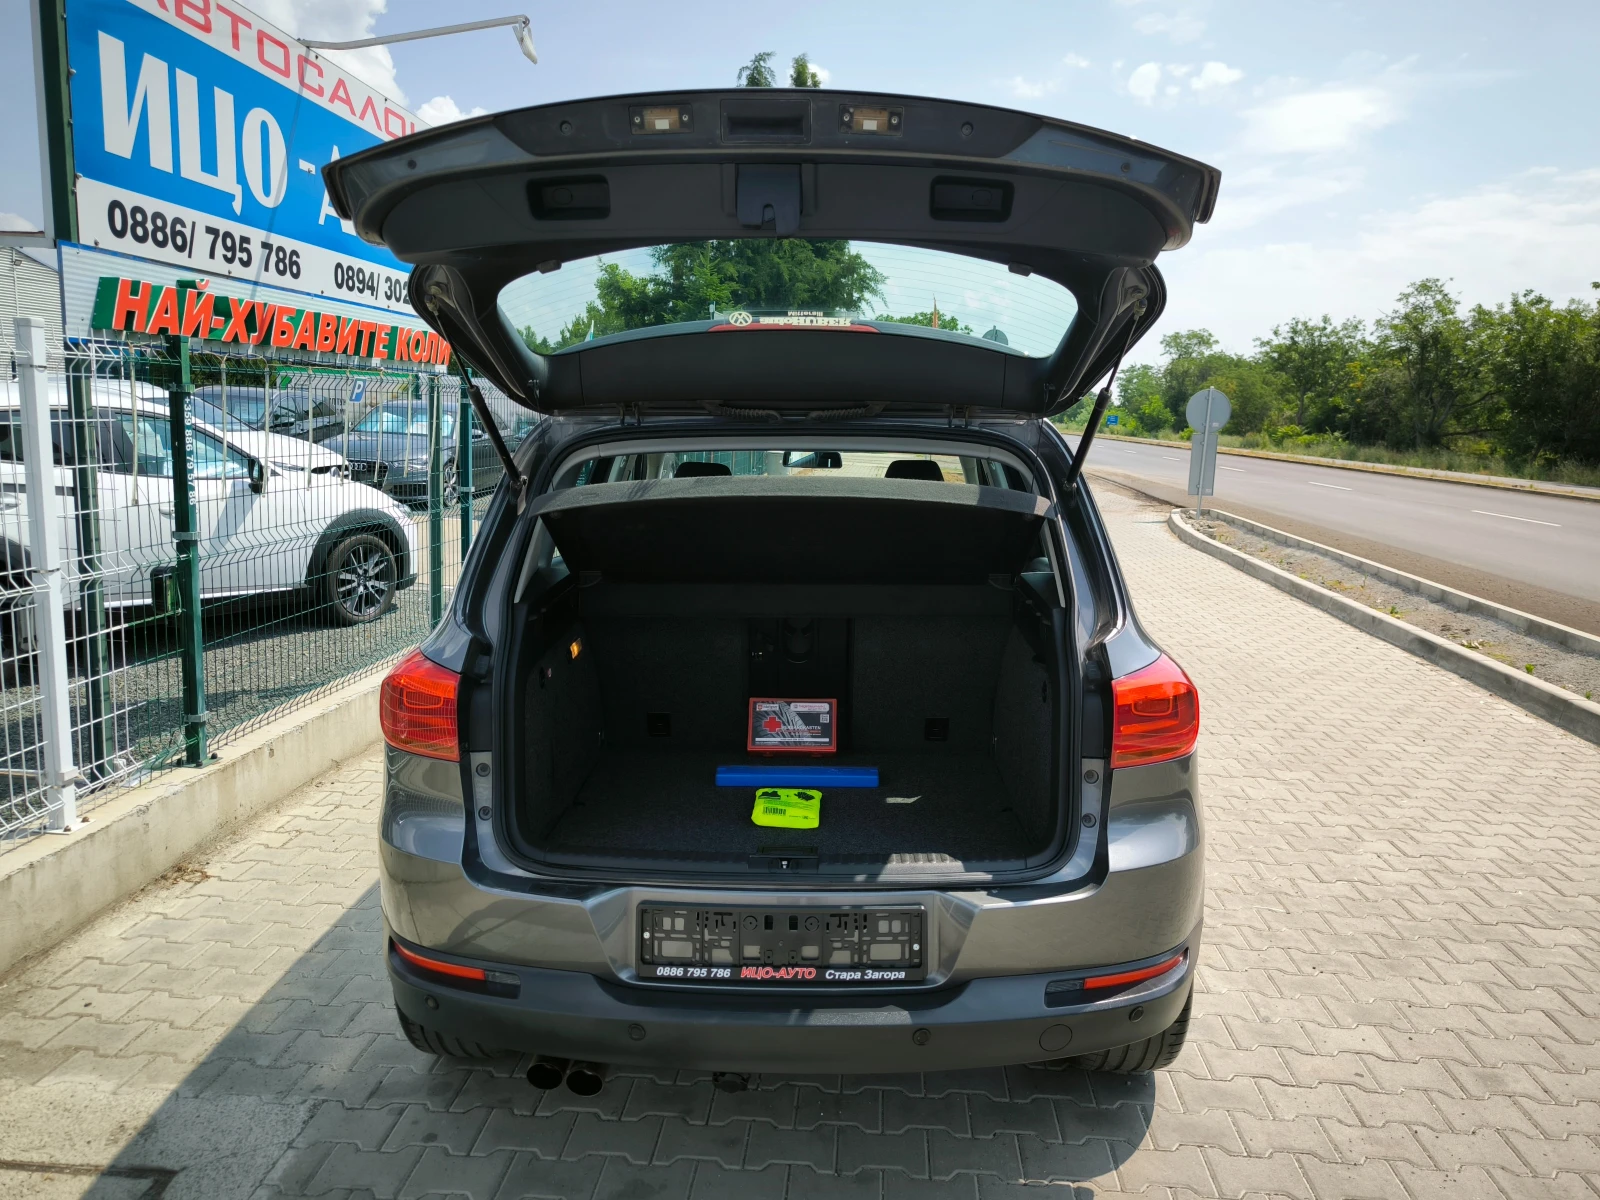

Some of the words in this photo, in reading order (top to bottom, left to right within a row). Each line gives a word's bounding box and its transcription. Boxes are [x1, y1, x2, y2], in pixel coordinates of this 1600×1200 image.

[156, 0, 415, 139] ВТОСАЛО
[205, 225, 252, 268] 795
[260, 241, 301, 280] 786
[112, 277, 391, 360] НАЙ-ХУБАВИТЕ
[395, 326, 451, 366] КОЛИ
[352, 381, 364, 399] P
[184, 396, 192, 425] +359
[185, 429, 193, 451] 886
[186, 455, 194, 469] 79
[188, 490, 197, 506] 86
[656, 967, 684, 976] 0886
[687, 968, 707, 977] 795
[710, 969, 731, 978] 786
[741, 966, 817, 979] ИЦО-АУТО
[825, 970, 862, 980] Стара
[864, 970, 906, 980] Загора
